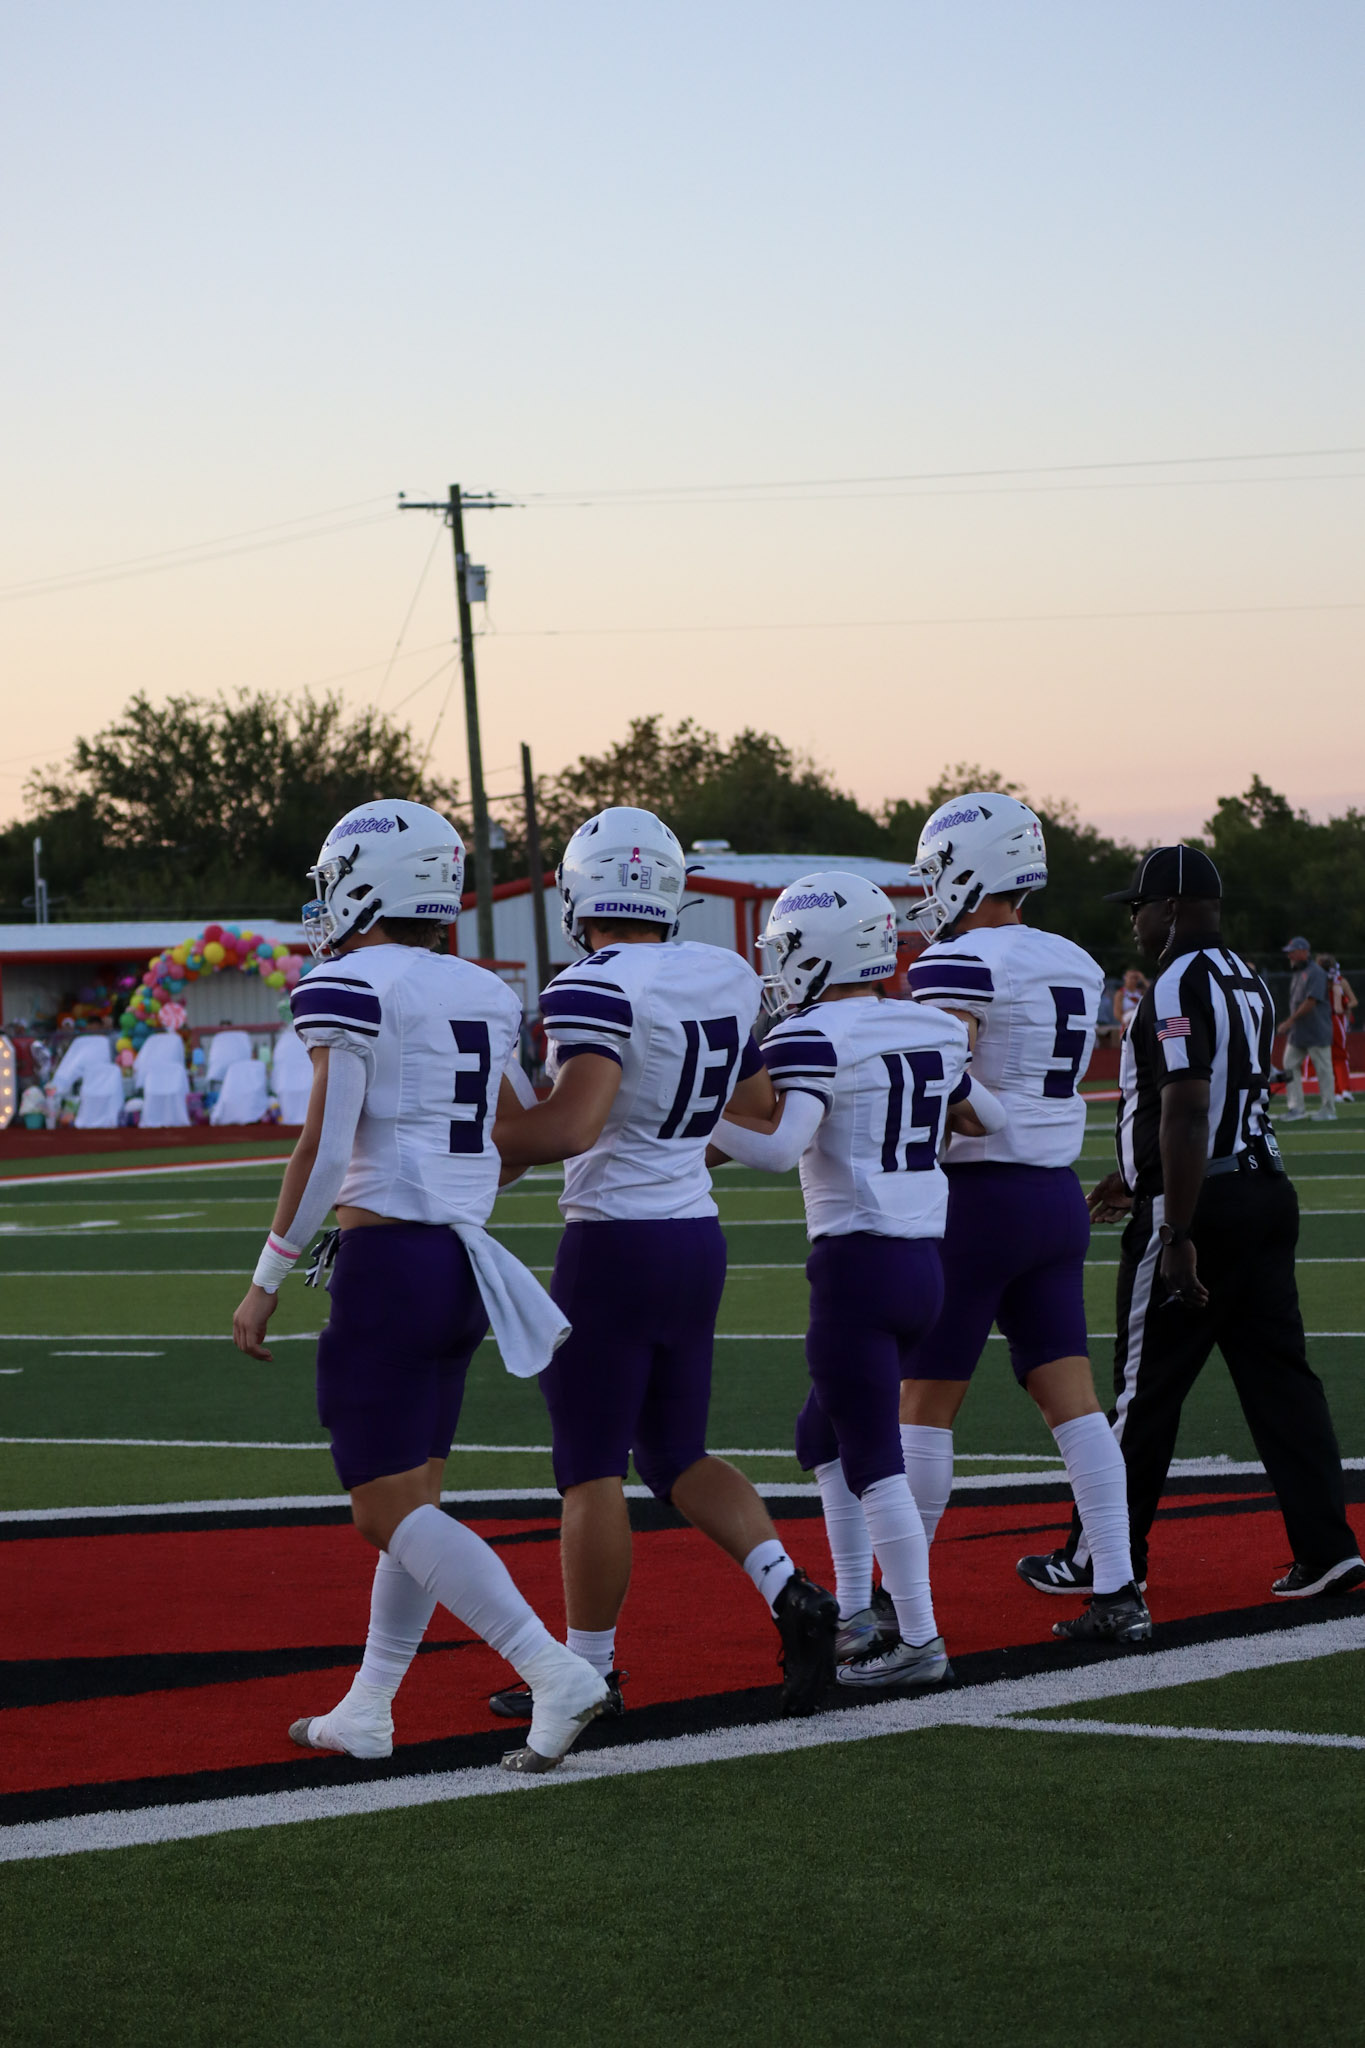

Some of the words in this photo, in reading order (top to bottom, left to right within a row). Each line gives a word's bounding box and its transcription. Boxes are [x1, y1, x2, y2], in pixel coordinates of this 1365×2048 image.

[594, 903, 667, 918] BONHAM
[449, 1020, 489, 1154] 3
[658, 1015, 739, 1139] 13
[1043, 986, 1086, 1098] 5
[881, 1051, 944, 1172] 15
